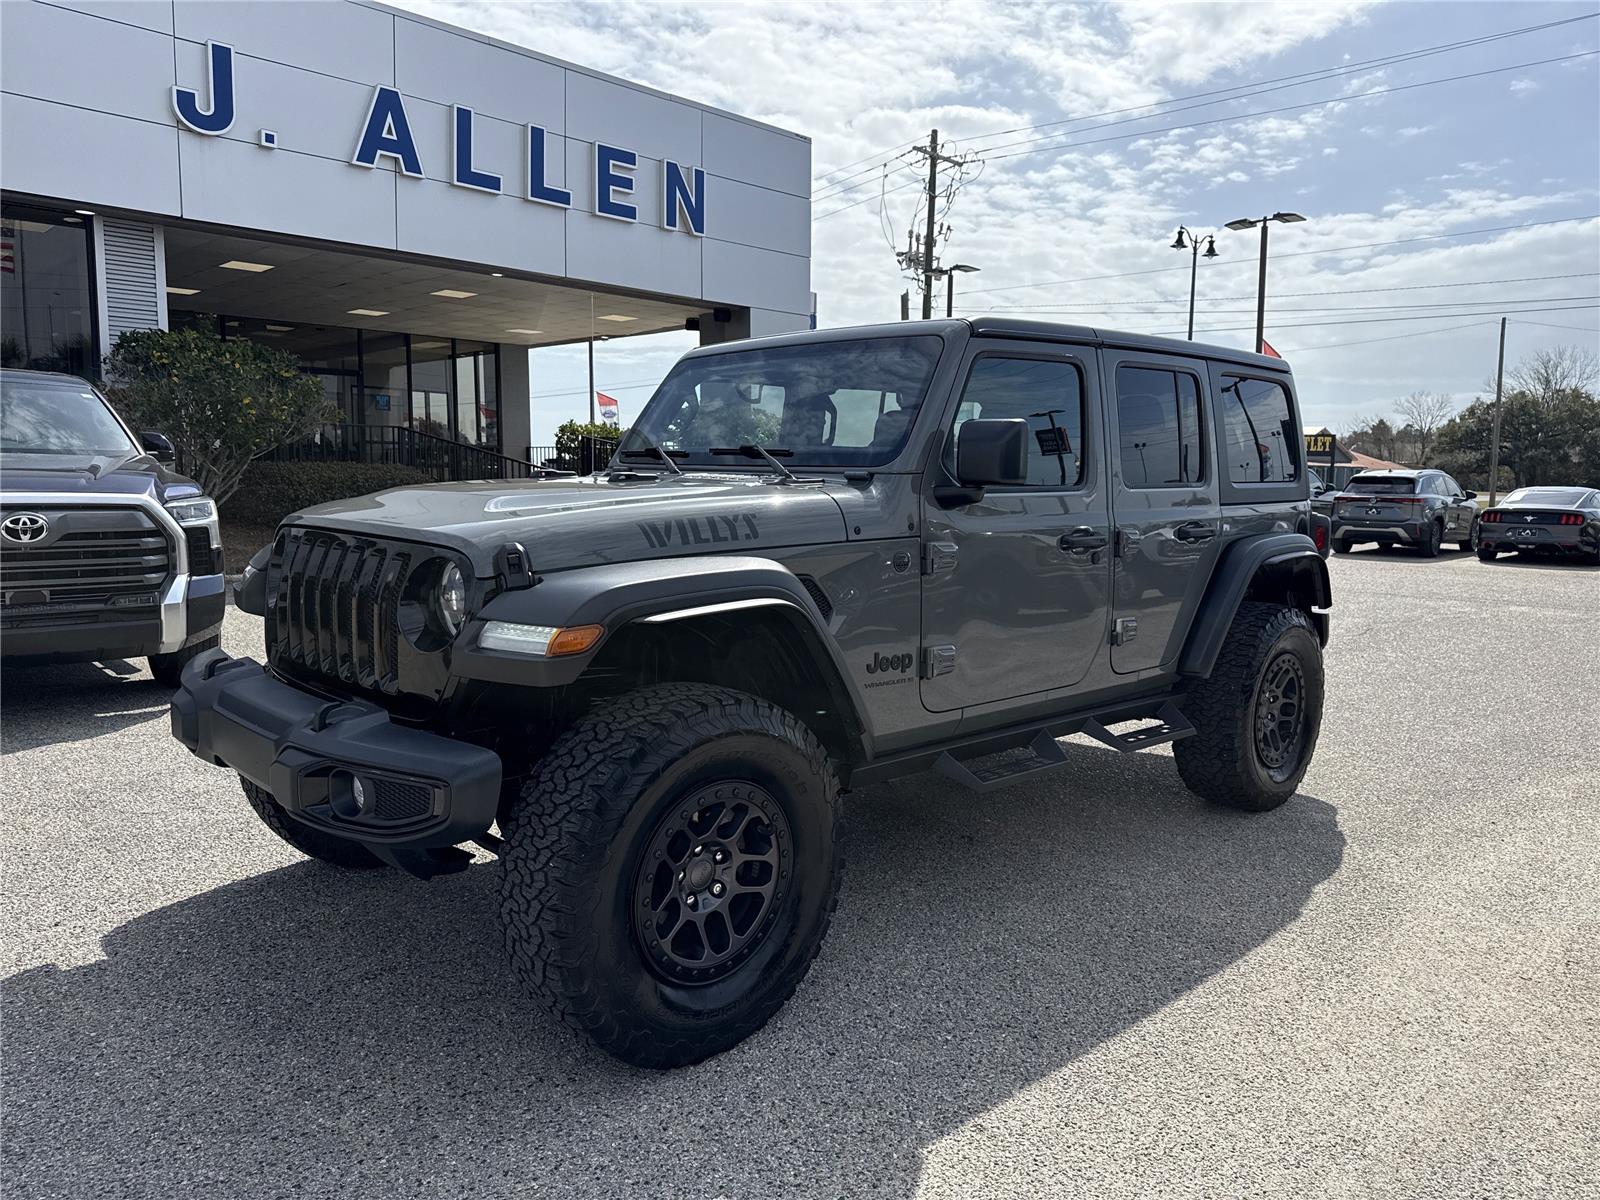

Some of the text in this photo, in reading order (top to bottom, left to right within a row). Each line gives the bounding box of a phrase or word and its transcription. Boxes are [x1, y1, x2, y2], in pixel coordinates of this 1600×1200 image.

[171, 39, 706, 237] J. ALLEN
[635, 513, 760, 548] WILLYS
[866, 652, 914, 674] Jeep
